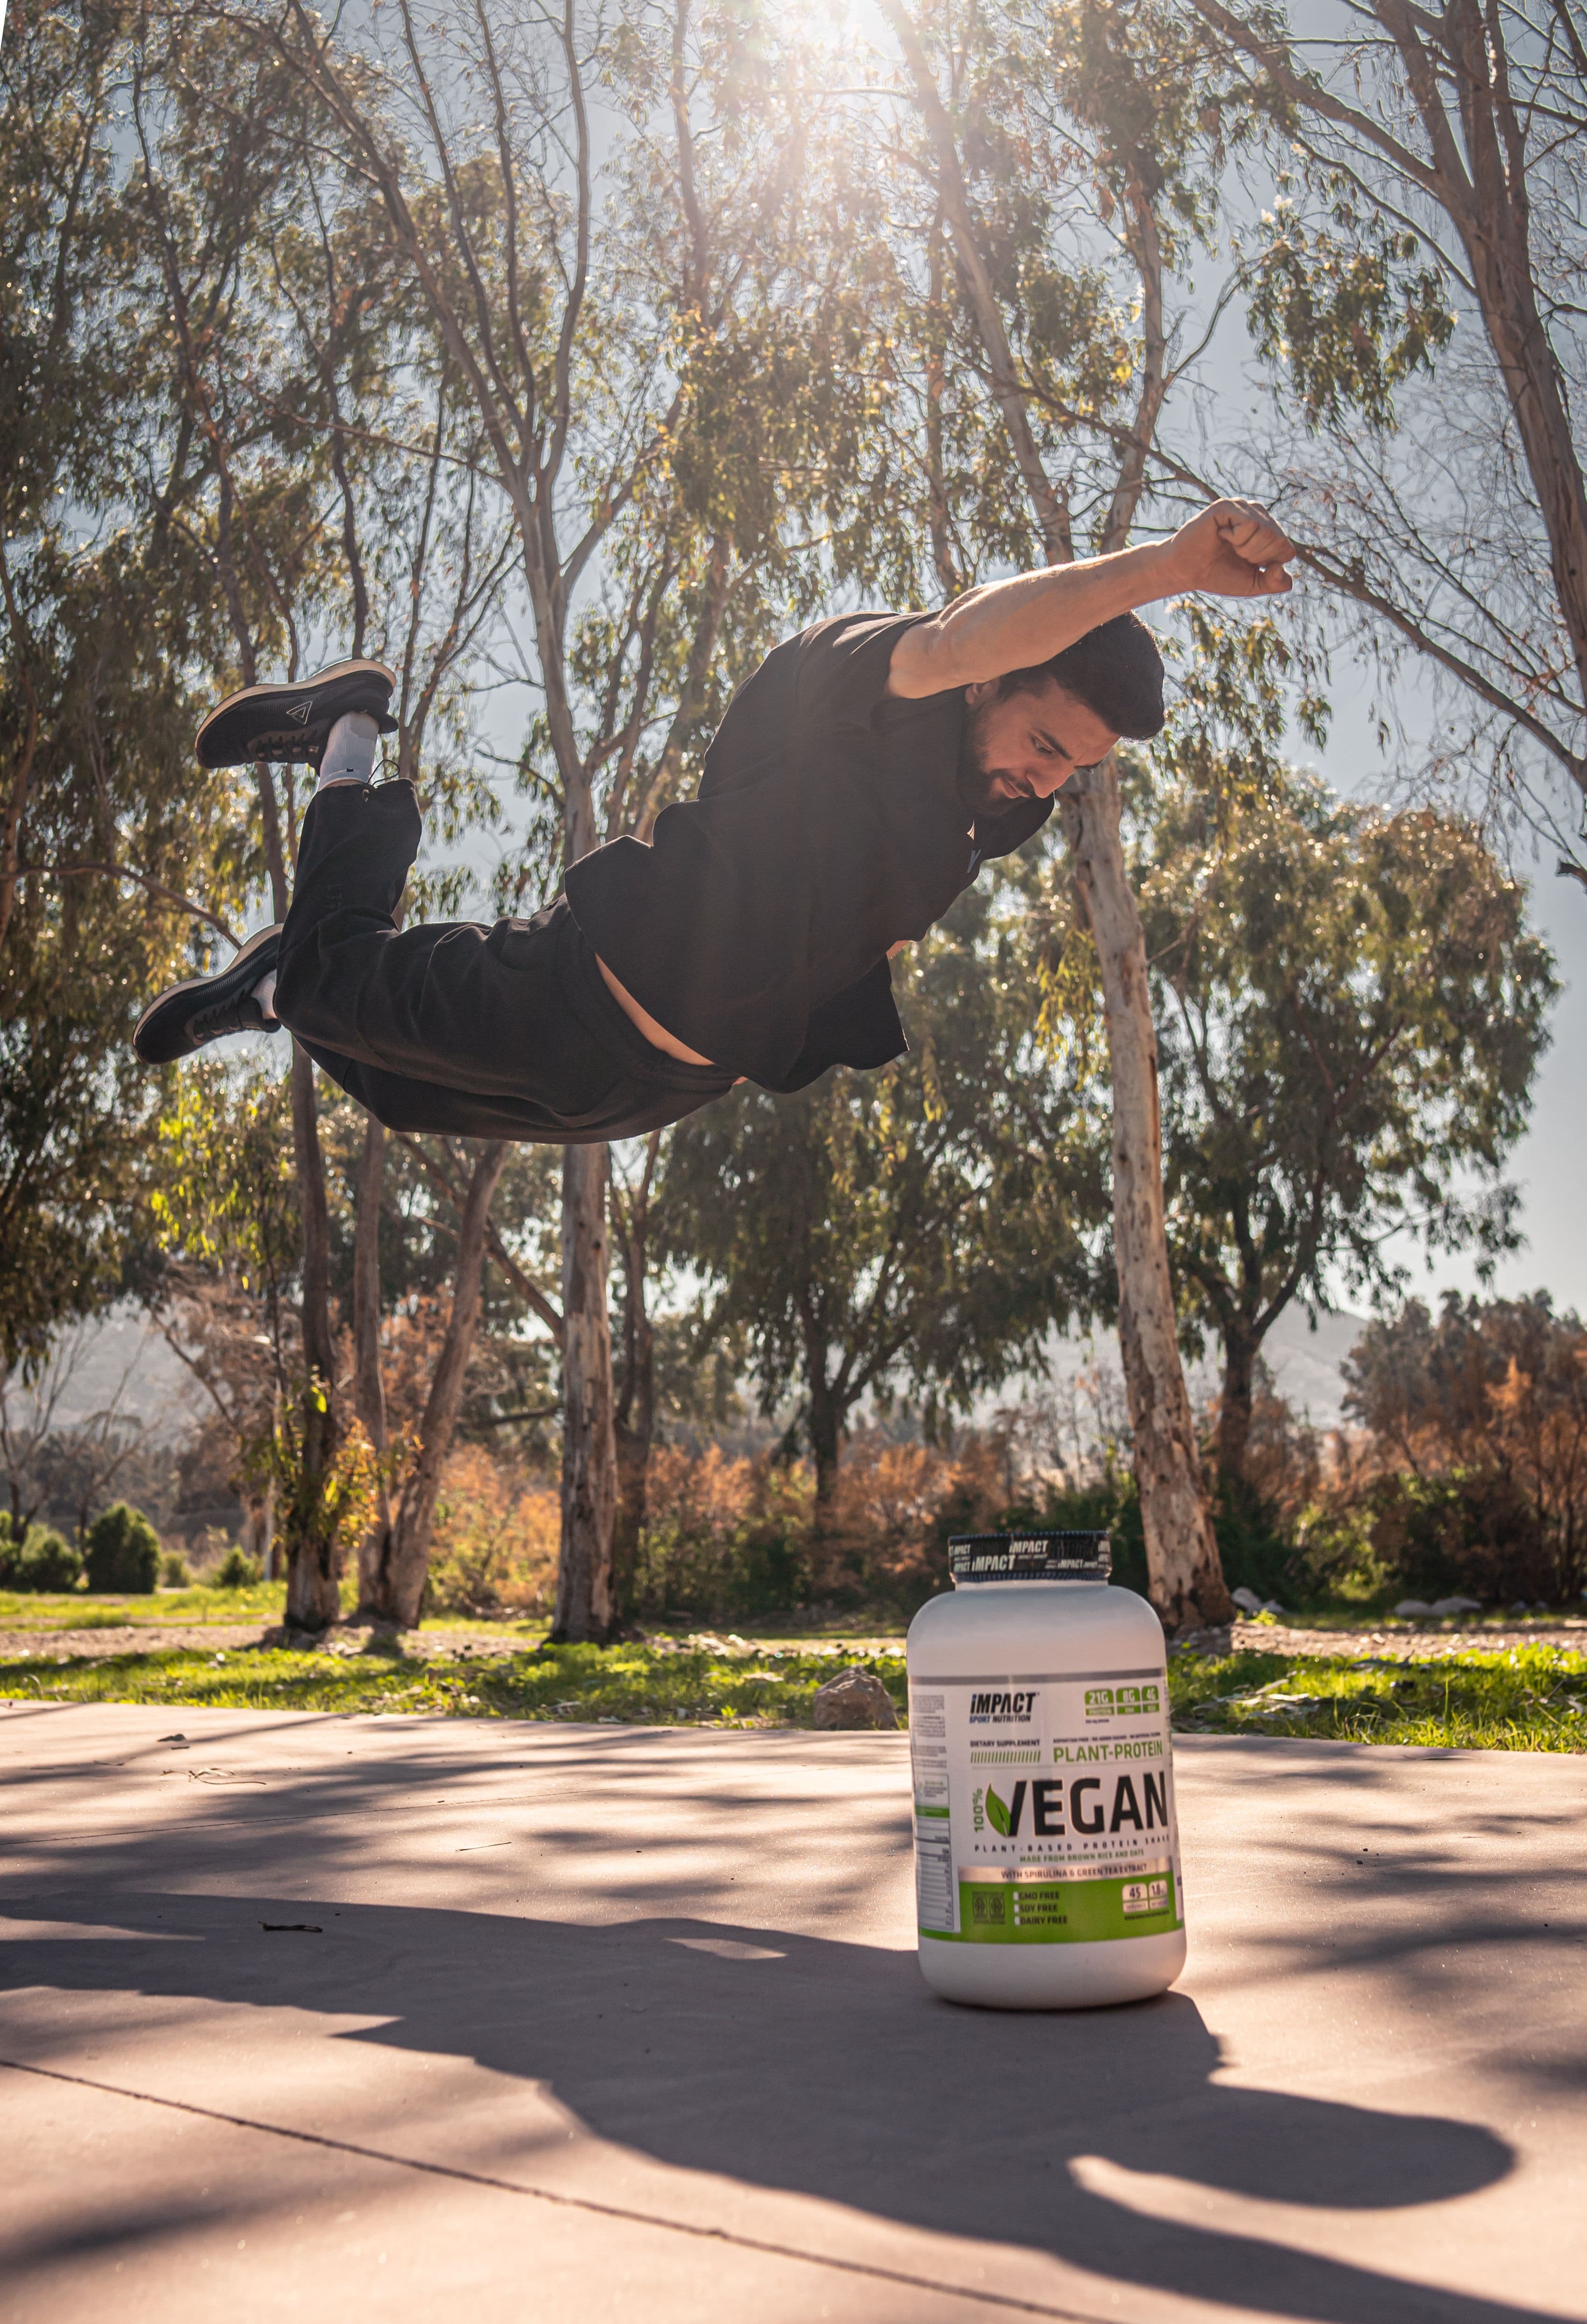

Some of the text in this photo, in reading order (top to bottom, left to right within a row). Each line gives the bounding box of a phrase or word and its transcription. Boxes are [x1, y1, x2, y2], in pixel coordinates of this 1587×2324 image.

[1089, 1691, 1109, 1704] 21G
[997, 1739, 1040, 1747] SUPPLEMENT
[1053, 1740, 1163, 1763] PLANT-PROTEIN
[973, 1788, 984, 1833] 100%
[986, 1771, 1168, 1838] VEGAN
[1083, 1839, 1138, 1849] PROTEIN
[1067, 1853, 1095, 1861] BROWN
[1025, 1869, 1067, 1878] SPIRULINA
[1077, 1867, 1102, 1877] GREEN
[1119, 1863, 1147, 1873] EXTRACT
[1130, 1886, 1140, 1899] 45
[1047, 1916, 1067, 1924] FREE
